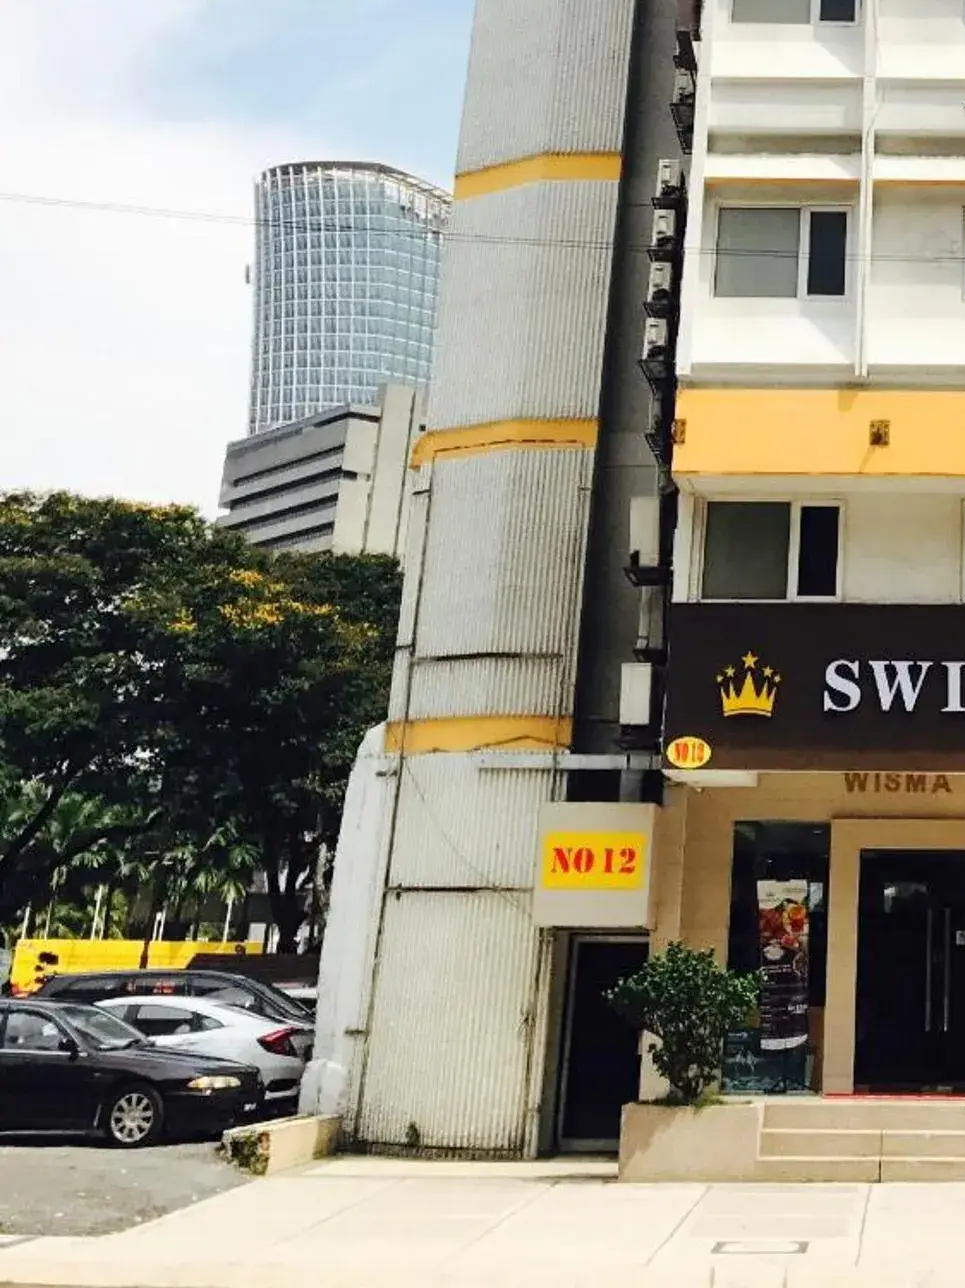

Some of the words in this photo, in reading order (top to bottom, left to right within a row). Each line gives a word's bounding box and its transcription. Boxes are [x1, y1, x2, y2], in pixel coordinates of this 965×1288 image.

[842, 772, 952, 794] WISMA
[550, 846, 595, 874] NO
[603, 847, 637, 874] 12
